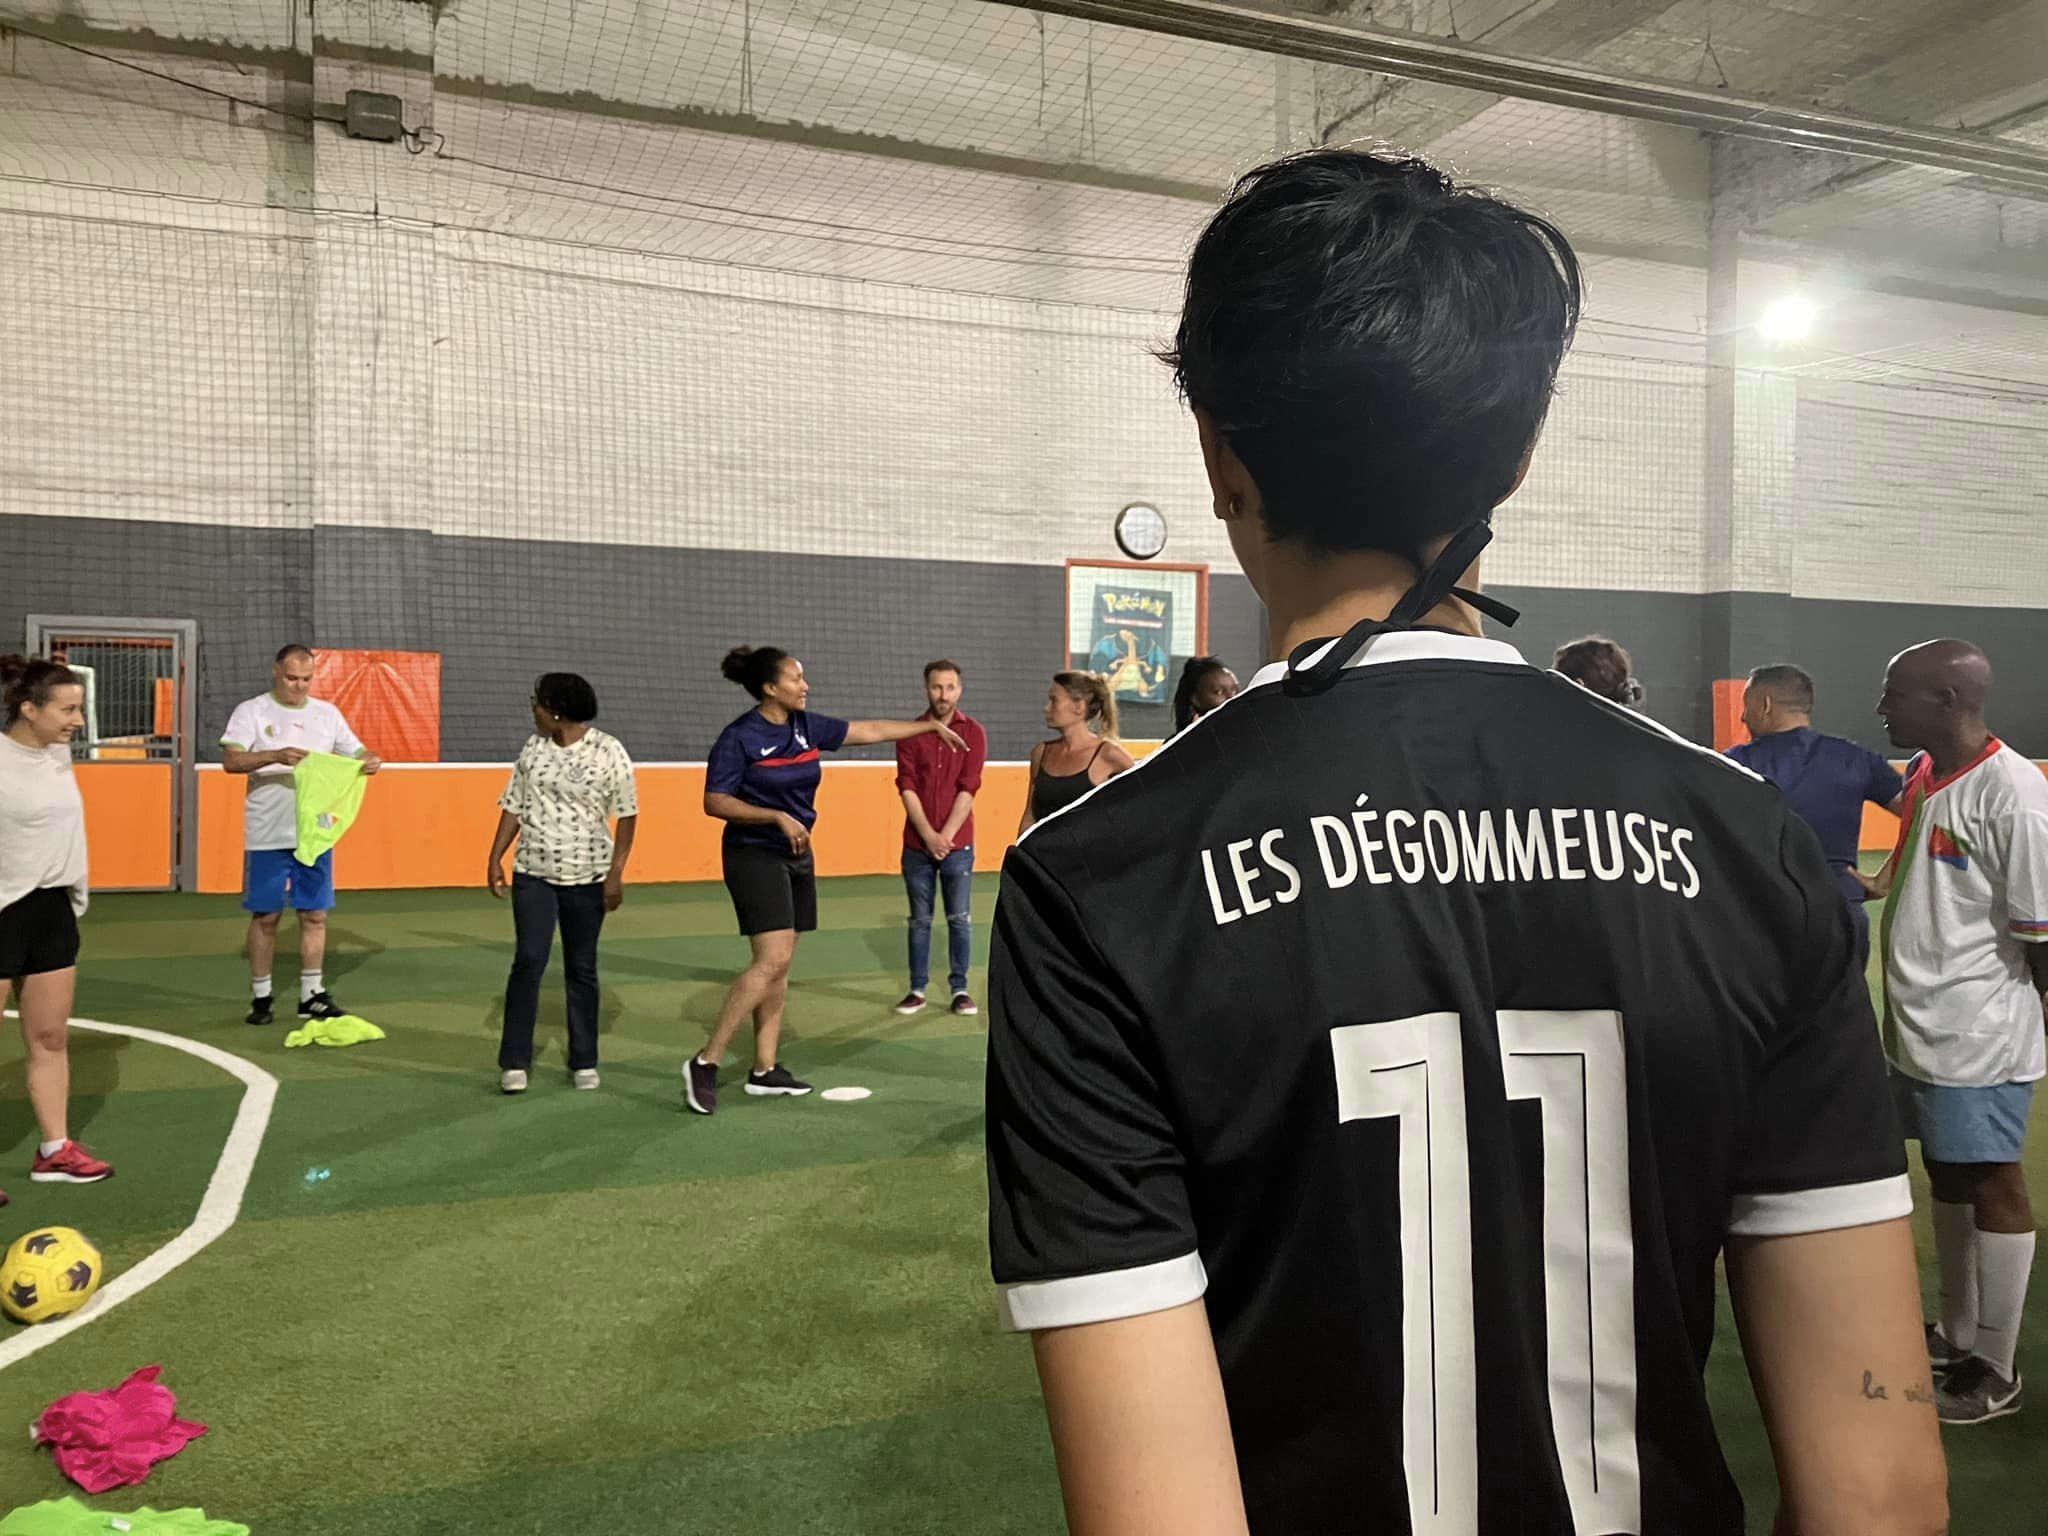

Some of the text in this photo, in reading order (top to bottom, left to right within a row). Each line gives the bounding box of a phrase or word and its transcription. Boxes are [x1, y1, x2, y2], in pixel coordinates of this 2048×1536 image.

[1200, 792, 1701, 925] LES DÉGOMMEUSES
[1330, 1010, 1642, 1536] 11
[1860, 1369, 1888, 1400] la
